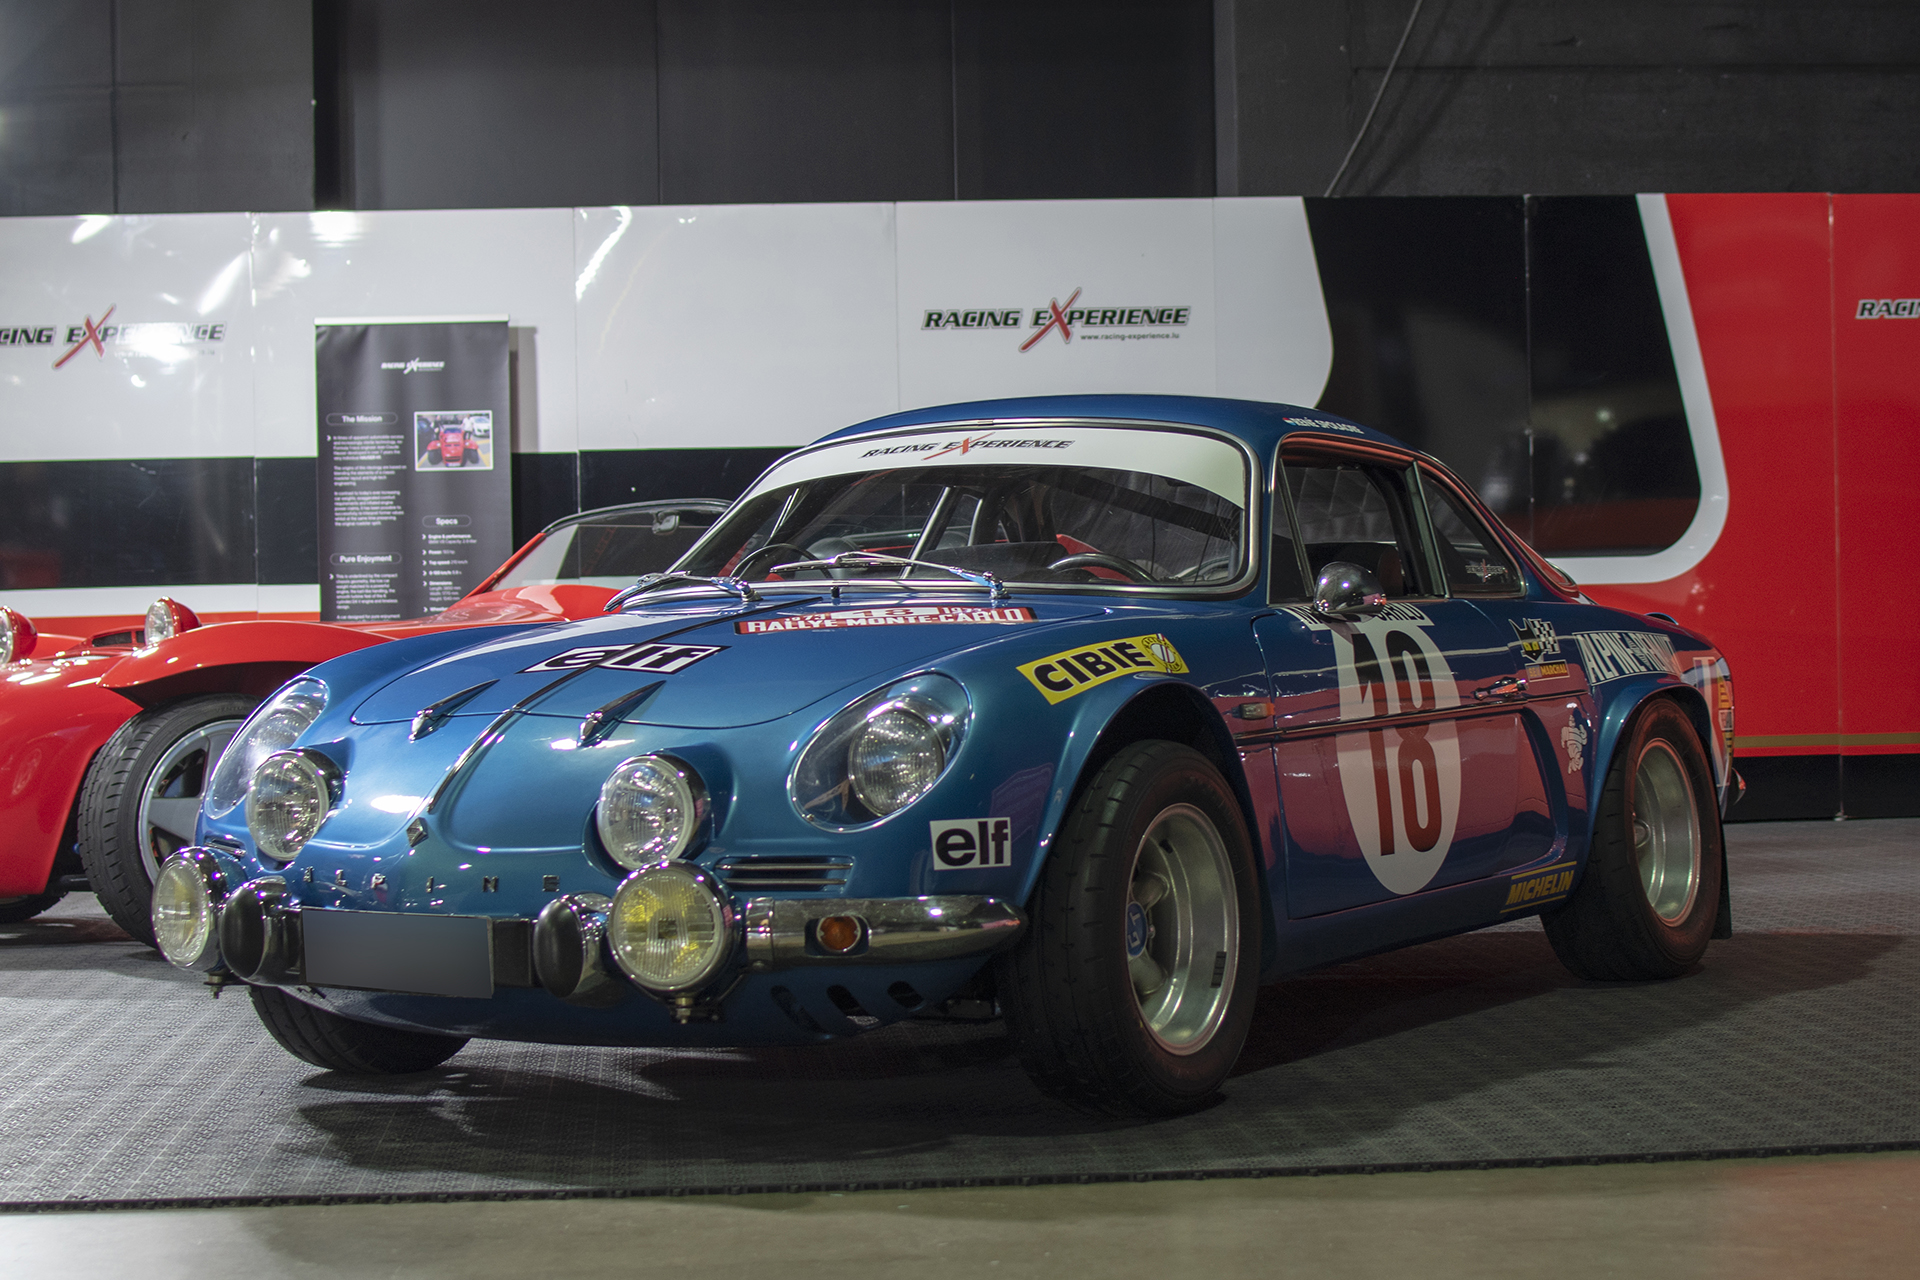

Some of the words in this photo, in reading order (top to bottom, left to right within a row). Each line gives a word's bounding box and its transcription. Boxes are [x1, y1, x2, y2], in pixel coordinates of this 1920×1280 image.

[923, 310, 1021, 328] RACING
[1020, 288, 1190, 351] EXPERIENCE
[1858, 301, 1920, 318] RACI
[1080, 332, 1180, 341] www.racing-experience.lu
[342, 415, 355, 423] The
[356, 415, 383, 423] Mission
[860, 442, 940, 458] RACING
[922, 432, 1075, 460] EXPERIENCE
[436, 518, 458, 526] Specs
[340, 555, 356, 563] Pure
[357, 555, 392, 564] Enjoyment
[747, 619, 838, 632] RALLYE
[846, 609, 1024, 626] MONTE-CARLO
[544, 645, 713, 668] elf
[1576, 632, 1648, 683] ALPINE
[1351, 630, 1442, 856] 18
[935, 819, 1009, 867] elf
[1505, 870, 1574, 905] MICHELIN
